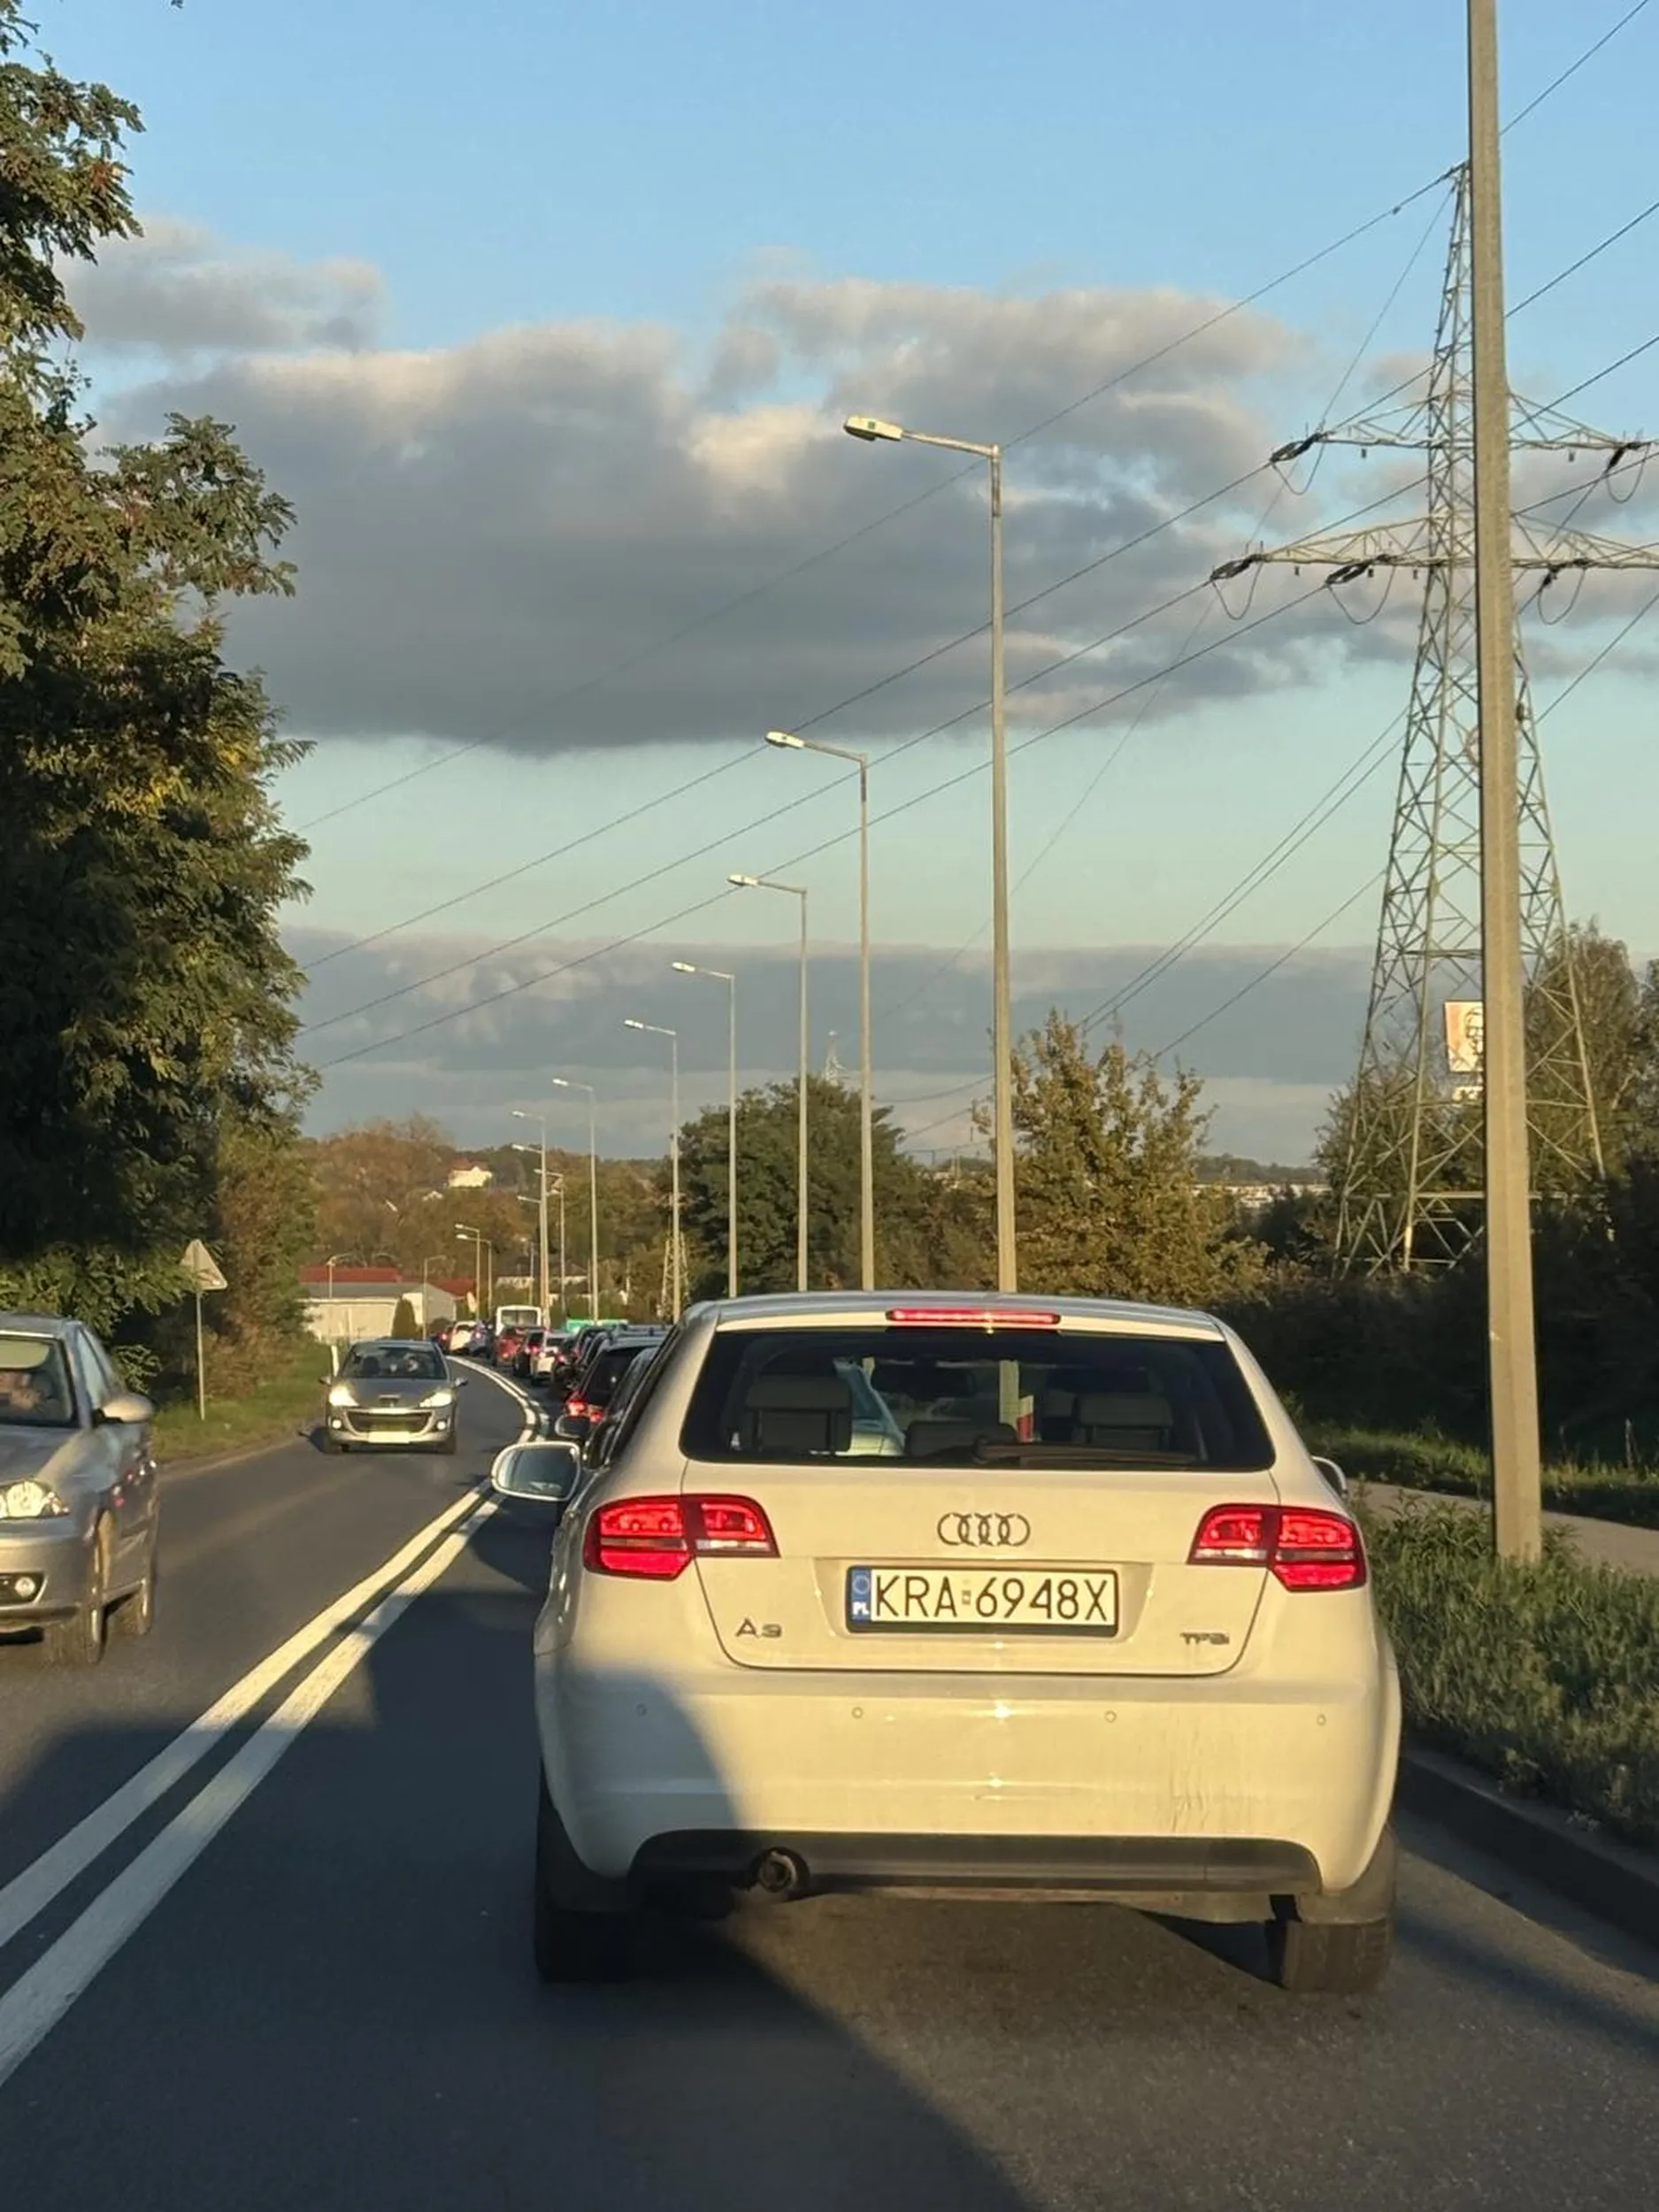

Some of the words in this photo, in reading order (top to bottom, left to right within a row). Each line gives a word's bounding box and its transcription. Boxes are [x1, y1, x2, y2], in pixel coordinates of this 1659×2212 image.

[852, 1601, 869, 1615] PL
[876, 1575, 957, 1617] KRA
[975, 1577, 1107, 1622] 6948X
[734, 1617, 782, 1639] A3
